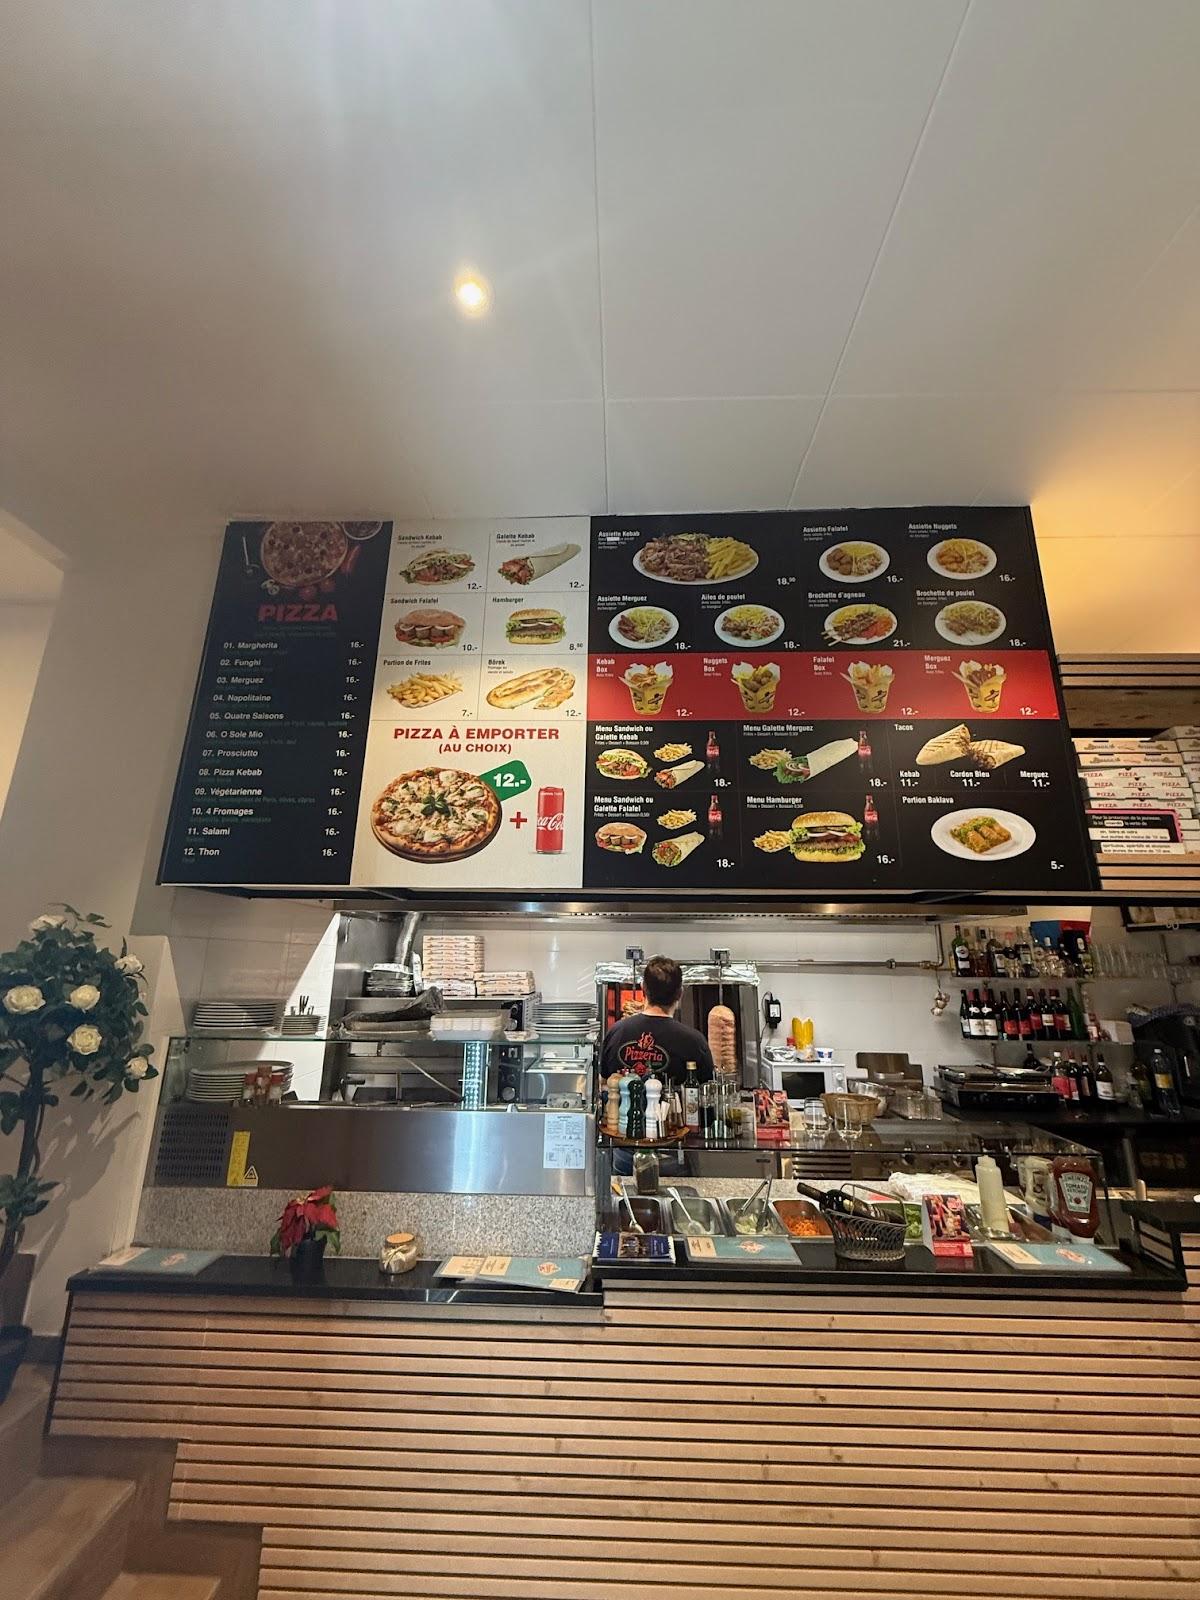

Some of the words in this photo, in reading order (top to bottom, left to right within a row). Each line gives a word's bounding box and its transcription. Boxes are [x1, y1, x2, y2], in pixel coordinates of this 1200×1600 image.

[258, 604, 338, 621] PIZZA
[231, 677, 264, 685] Merguez
[227, 694, 271, 703] Napolitaine
[394, 728, 443, 739] PIZZA
[449, 725, 460, 739] À
[466, 728, 559, 739] EMPORTER
[438, 743, 462, 754] (AU
[465, 743, 512, 754] CHOIX)
[1020, 771, 1049, 779] Merguez
[493, 773, 527, 788] 12.-
[901, 779, 918, 787] 11.-
[962, 779, 981, 787] 11.-
[1032, 779, 1050, 788] 11.-
[766, 796, 802, 804] Hamburger
[213, 808, 253, 817] Fromages
[877, 855, 895, 864] 16.-
[1051, 861, 1064, 869] 5.-
[624, 1046, 663, 1061] Pizzeria
